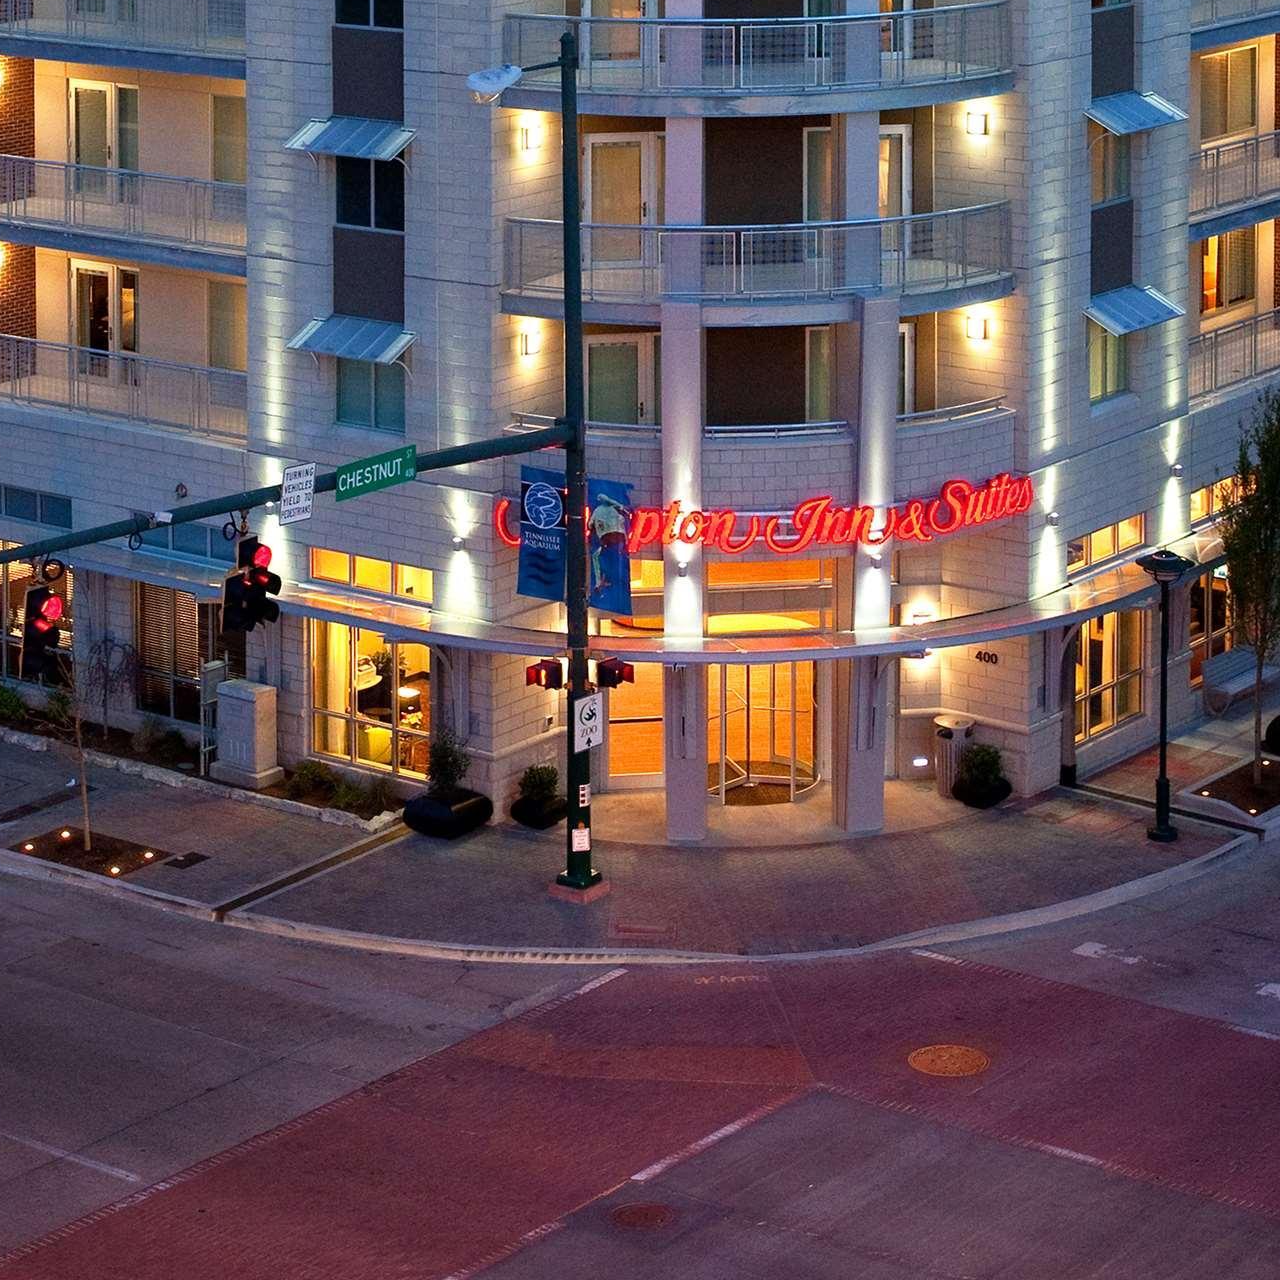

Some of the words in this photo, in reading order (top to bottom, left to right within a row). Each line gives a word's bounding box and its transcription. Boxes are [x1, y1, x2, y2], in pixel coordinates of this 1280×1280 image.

[286, 467, 314, 481] TURNING
[338, 458, 403, 492] CHESTNUT
[284, 480, 313, 494] VEHICLES
[283, 495, 301, 507] YIELD
[304, 492, 312, 502] TO
[281, 505, 311, 520] PEDESTRIANS
[766, 495, 895, 554] Inn
[894, 501, 932, 542] &
[928, 472, 1034, 533] Suites
[524, 540, 560, 551] AQUARIUM
[975, 651, 998, 665] 400
[580, 724, 598, 738] ZOO
